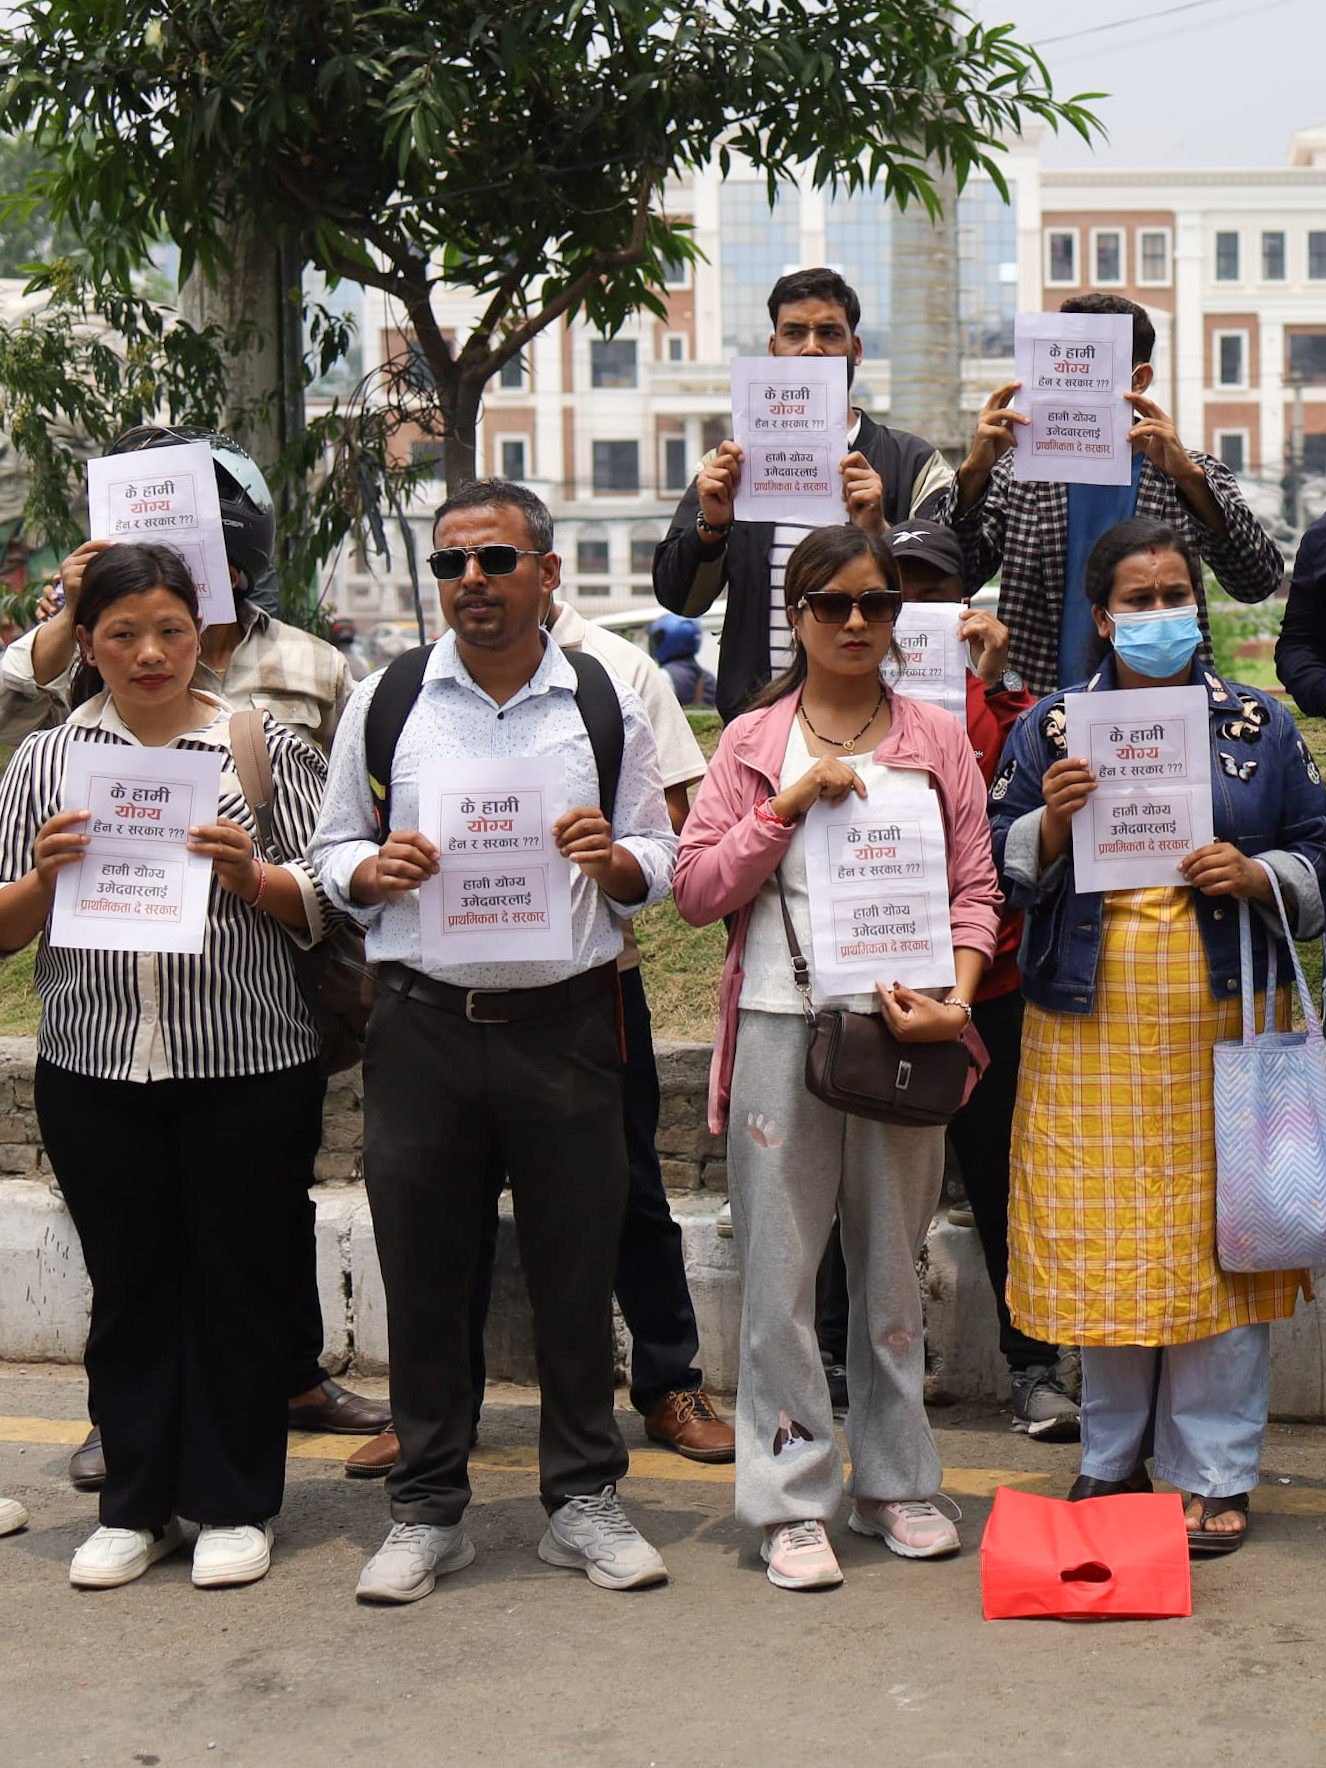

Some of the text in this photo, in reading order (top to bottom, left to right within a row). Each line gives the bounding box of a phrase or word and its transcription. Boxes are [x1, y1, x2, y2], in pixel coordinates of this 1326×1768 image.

[1050, 344, 1096, 359] के हामी
[1054, 360, 1091, 374] योग्य
[1056, 379, 1061, 387] र
[1065, 379, 1093, 388] सरकार
[1096, 379, 1109, 387] ???
[765, 387, 810, 400] के हामी
[770, 402, 805, 415] योग्य
[1048, 411, 1096, 422] हामी योग्य
[1046, 426, 1100, 439] उमेदवारलाई
[1036, 441, 1111, 454] प्राथमिकता दे सरकार
[766, 452, 813, 462] हामी योग्य
[764, 467, 818, 477] उमेदवारलाई
[125, 480, 175, 499] के हामी
[754, 481, 828, 492] प्राथमिकता दे सरकार
[130, 500, 171, 514] योग्य
[134, 520, 141, 528] र
[144, 516, 176, 528] सरकार
[179, 515, 194, 523] ???
[1110, 725, 1165, 742] के हामी
[1116, 745, 1159, 760] योग्य
[1120, 767, 1126, 776] र
[1131, 765, 1166, 775] सरकार
[1168, 763, 1183, 773] ???
[111, 783, 171, 803] के हामी
[115, 803, 162, 820] योग्य
[461, 796, 520, 814] के हामी
[1112, 803, 1171, 817] हामी योग्य
[116, 825, 124, 834] र
[128, 826, 165, 836] सरकार
[169, 828, 184, 838] ???
[467, 817, 514, 832] योग्य
[1110, 820, 1176, 835] उमेदवारलाई
[847, 826, 901, 843] के हामी
[471, 840, 479, 849] र
[482, 838, 519, 848] सरकार
[523, 837, 539, 846] ???
[1099, 838, 1190, 855] प्राथमिकता दे सरकार
[855, 845, 897, 860] योग्य
[102, 863, 165, 879] हामी योग्य
[859, 867, 864, 876] र
[870, 865, 903, 875] सरकार
[906, 863, 920, 873] ???
[97, 880, 169, 899] उमेदवारलाई
[463, 875, 526, 890] हामी योग्य
[81, 898, 178, 916] प्राथमिकता दे सरकार
[461, 893, 532, 907] उमेदवारलाई
[449, 910, 546, 927] प्राथमिकता दे सरकार
[853, 903, 910, 919] हामी योग्य
[851, 921, 916, 937] उमेदवारलाई
[841, 940, 929, 957] प्राथमिकता दे सरकार
